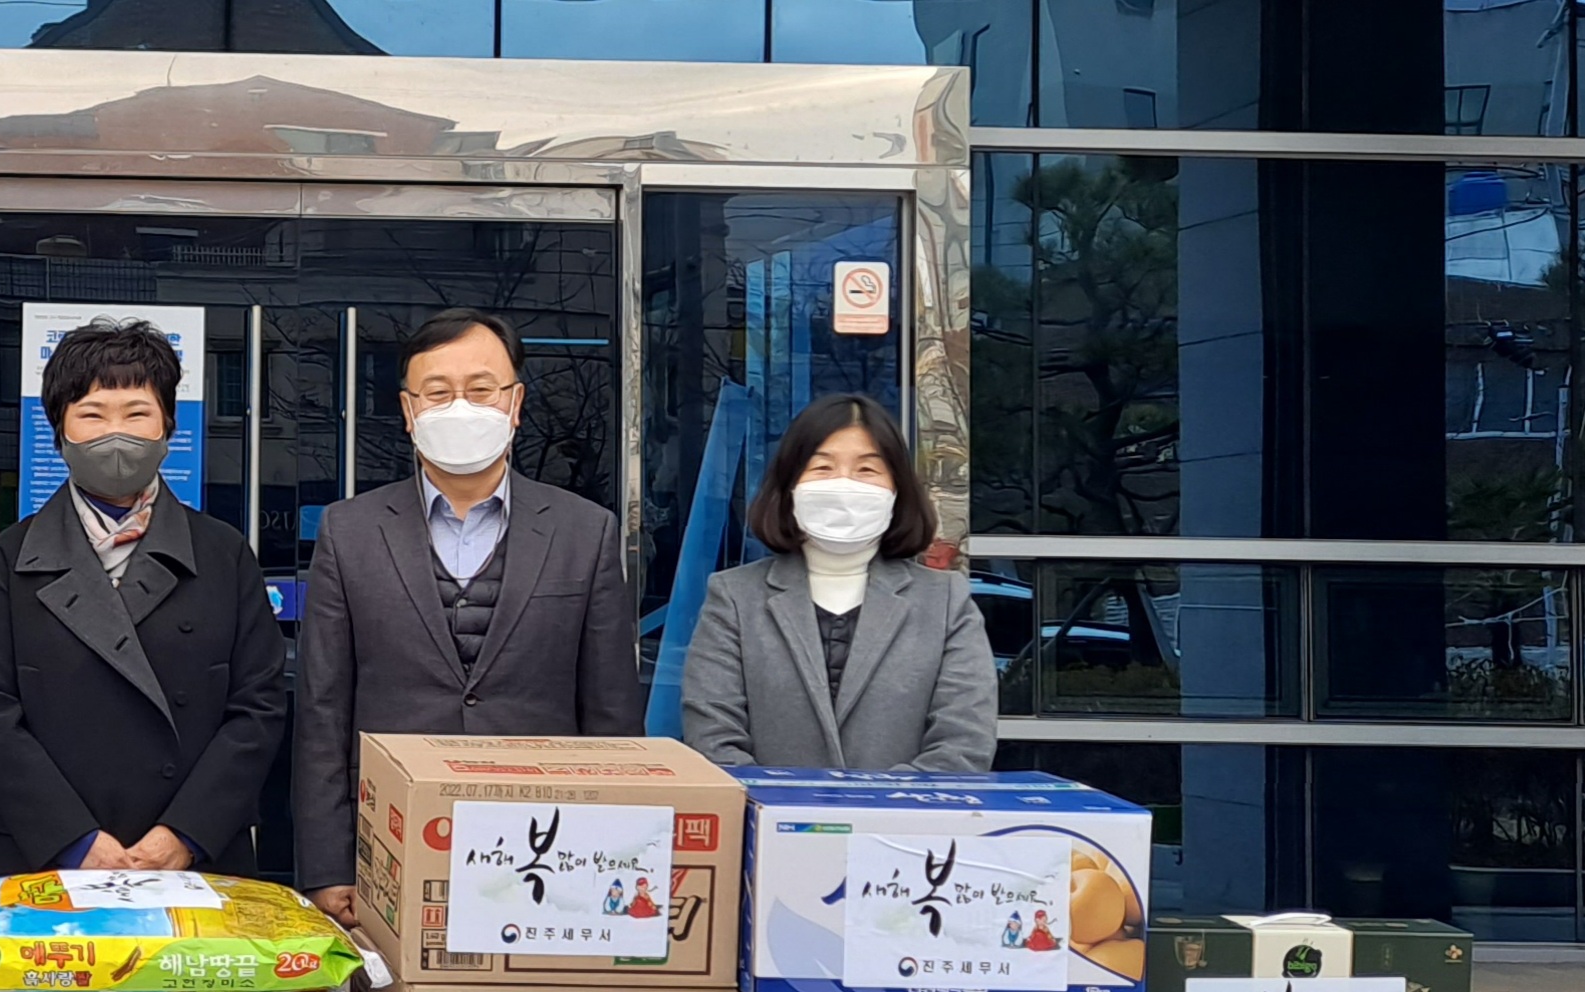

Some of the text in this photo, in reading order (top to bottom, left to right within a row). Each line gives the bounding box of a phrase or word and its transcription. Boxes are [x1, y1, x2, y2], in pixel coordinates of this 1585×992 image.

[466, 836, 513, 865] 새해
[515, 806, 559, 904] 복
[861, 868, 909, 897] 새해
[911, 838, 956, 937] 복
[525, 926, 611, 942] 진주세무서
[19, 941, 98, 968] 메뚜기
[155, 952, 260, 979] 해남땅끝
[922, 959, 1010, 976] 진주세무서
